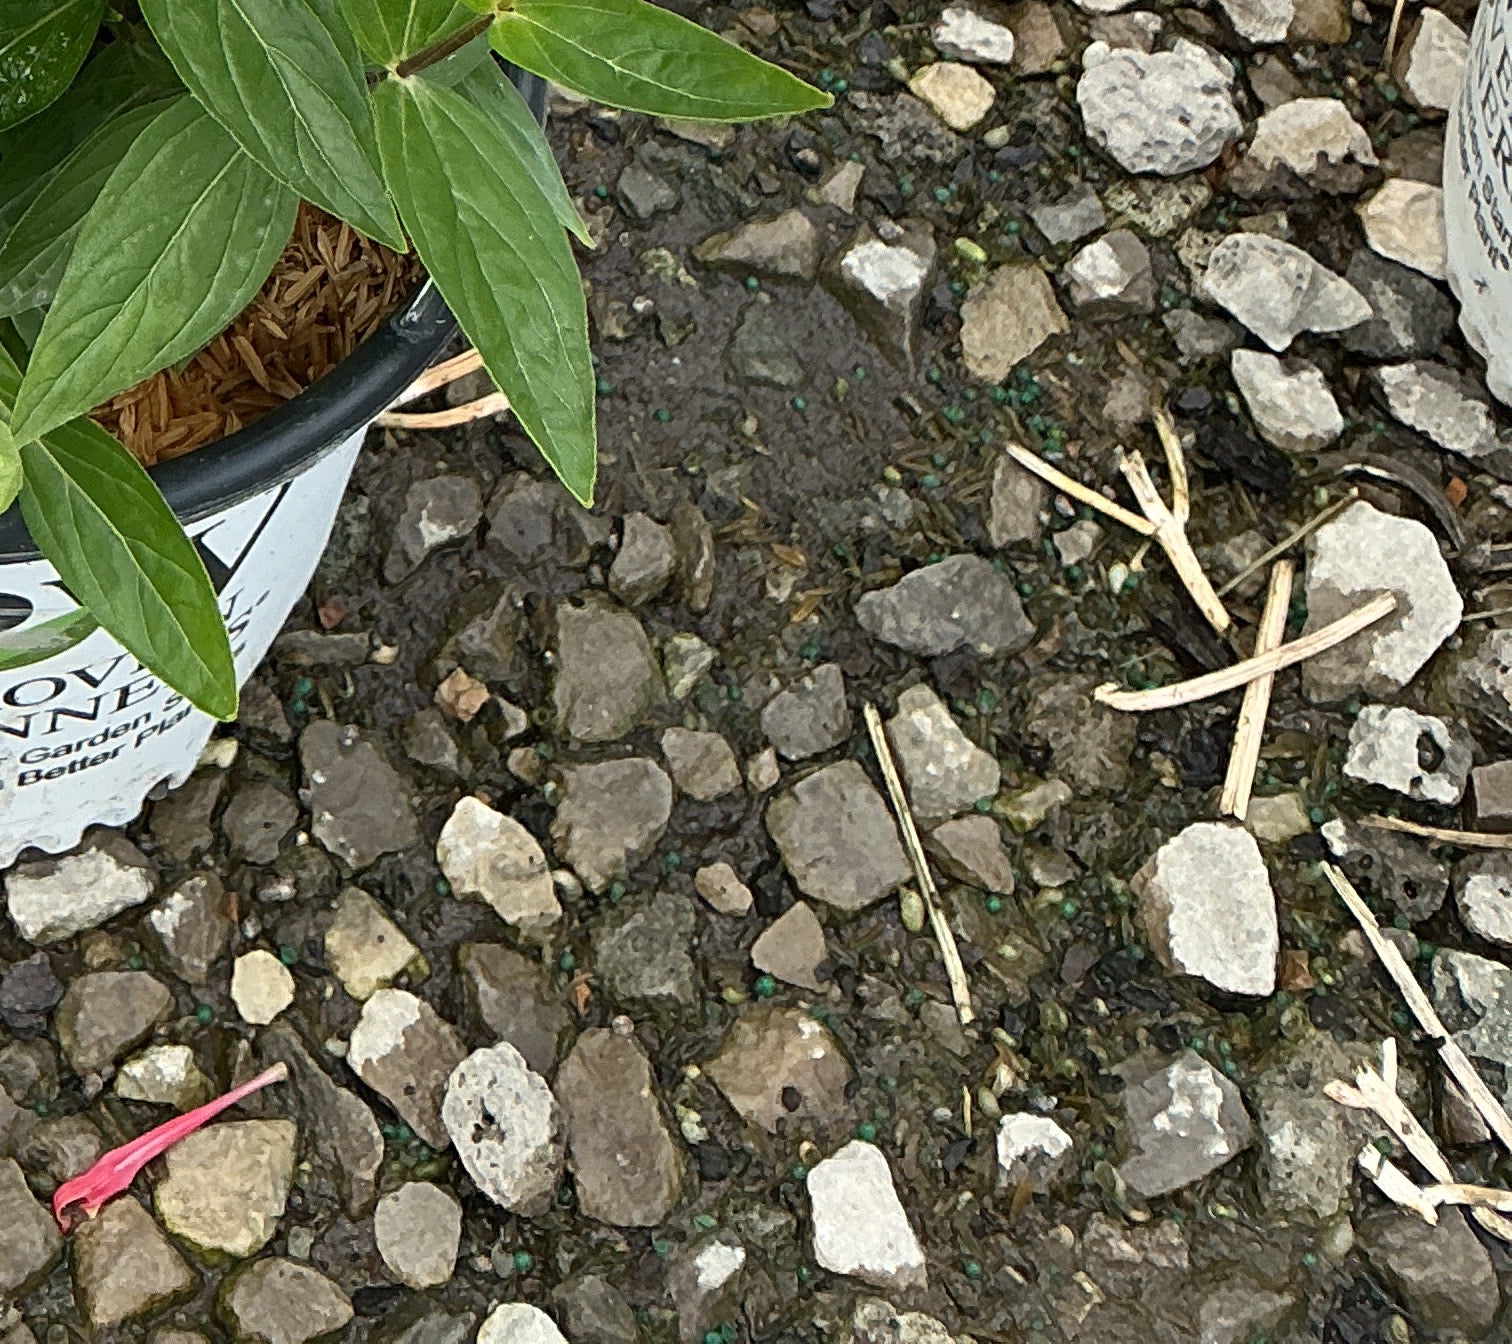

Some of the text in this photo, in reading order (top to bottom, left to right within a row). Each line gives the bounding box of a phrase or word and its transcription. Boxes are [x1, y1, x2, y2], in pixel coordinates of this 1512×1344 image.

[16, 741, 128, 787] Better
[133, 703, 193, 750] Pla
[18, 708, 152, 766] Garden
